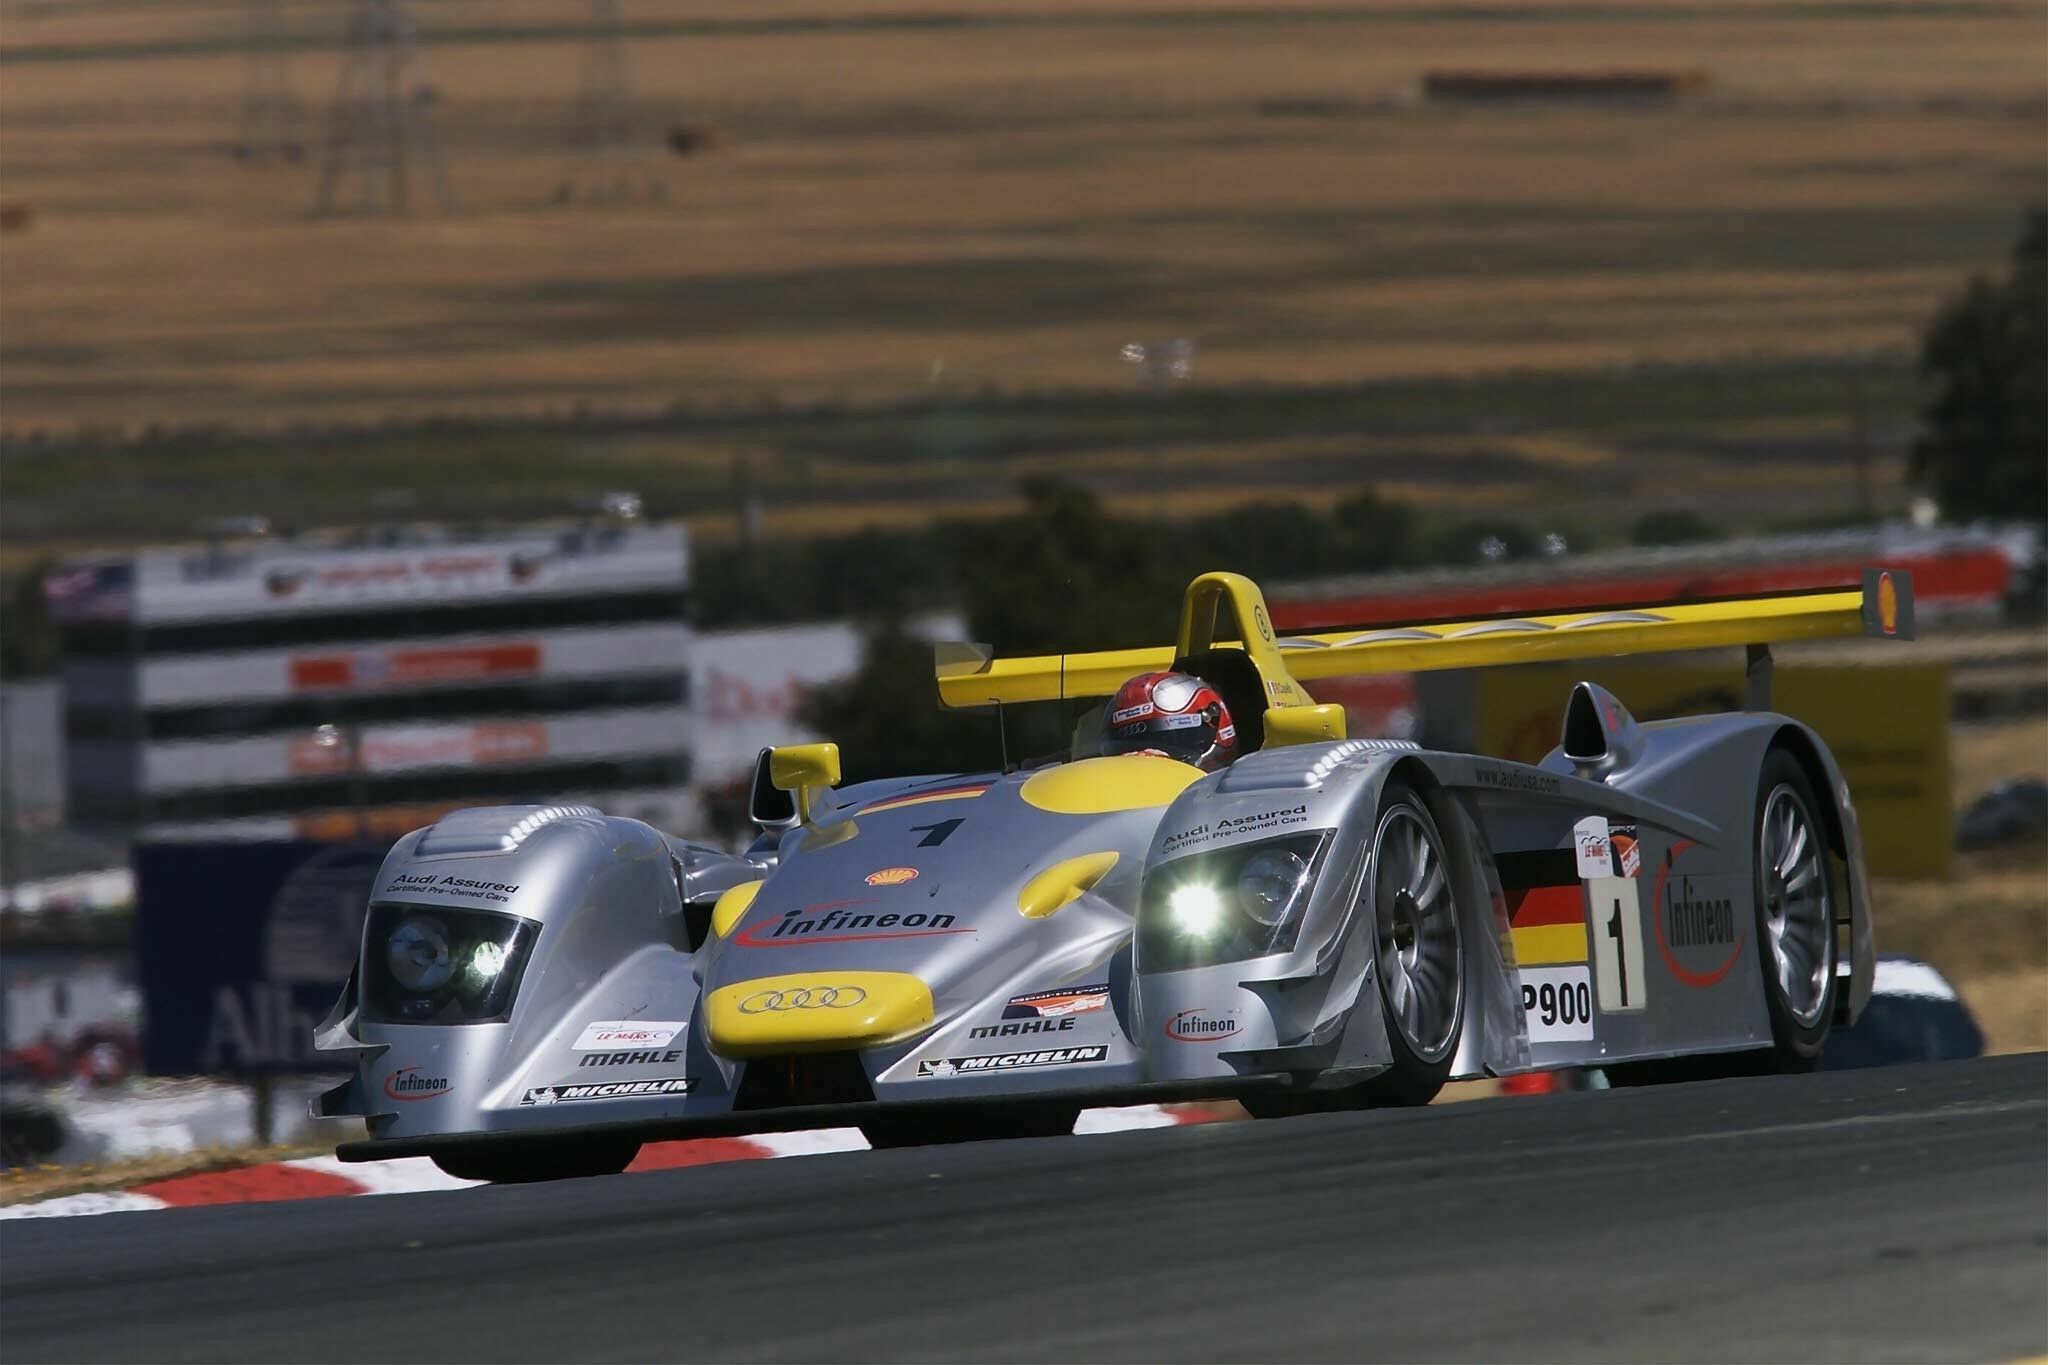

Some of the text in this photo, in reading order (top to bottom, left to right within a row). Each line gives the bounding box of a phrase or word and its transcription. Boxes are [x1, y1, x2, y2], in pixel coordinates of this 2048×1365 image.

[911, 817, 966, 848] 1
[1161, 814, 1308, 855] Certified Pre-Owned Cars
[1162, 804, 1307, 848] Audi Assured
[386, 884, 510, 903] Certified Pre-Owned Cars
[393, 874, 520, 893] Audi Assured
[772, 909, 957, 938] infineon
[1608, 898, 1629, 1008] 1
[1521, 981, 1591, 1027] P900
[969, 1017, 1076, 1039] MAHLE
[1176, 1012, 1236, 1034] infineon
[597, 1032, 611, 1041] LE
[578, 1050, 683, 1067] MAHLE
[960, 1047, 1102, 1070] MICHELIN
[561, 1080, 693, 1098] MICHELIN
